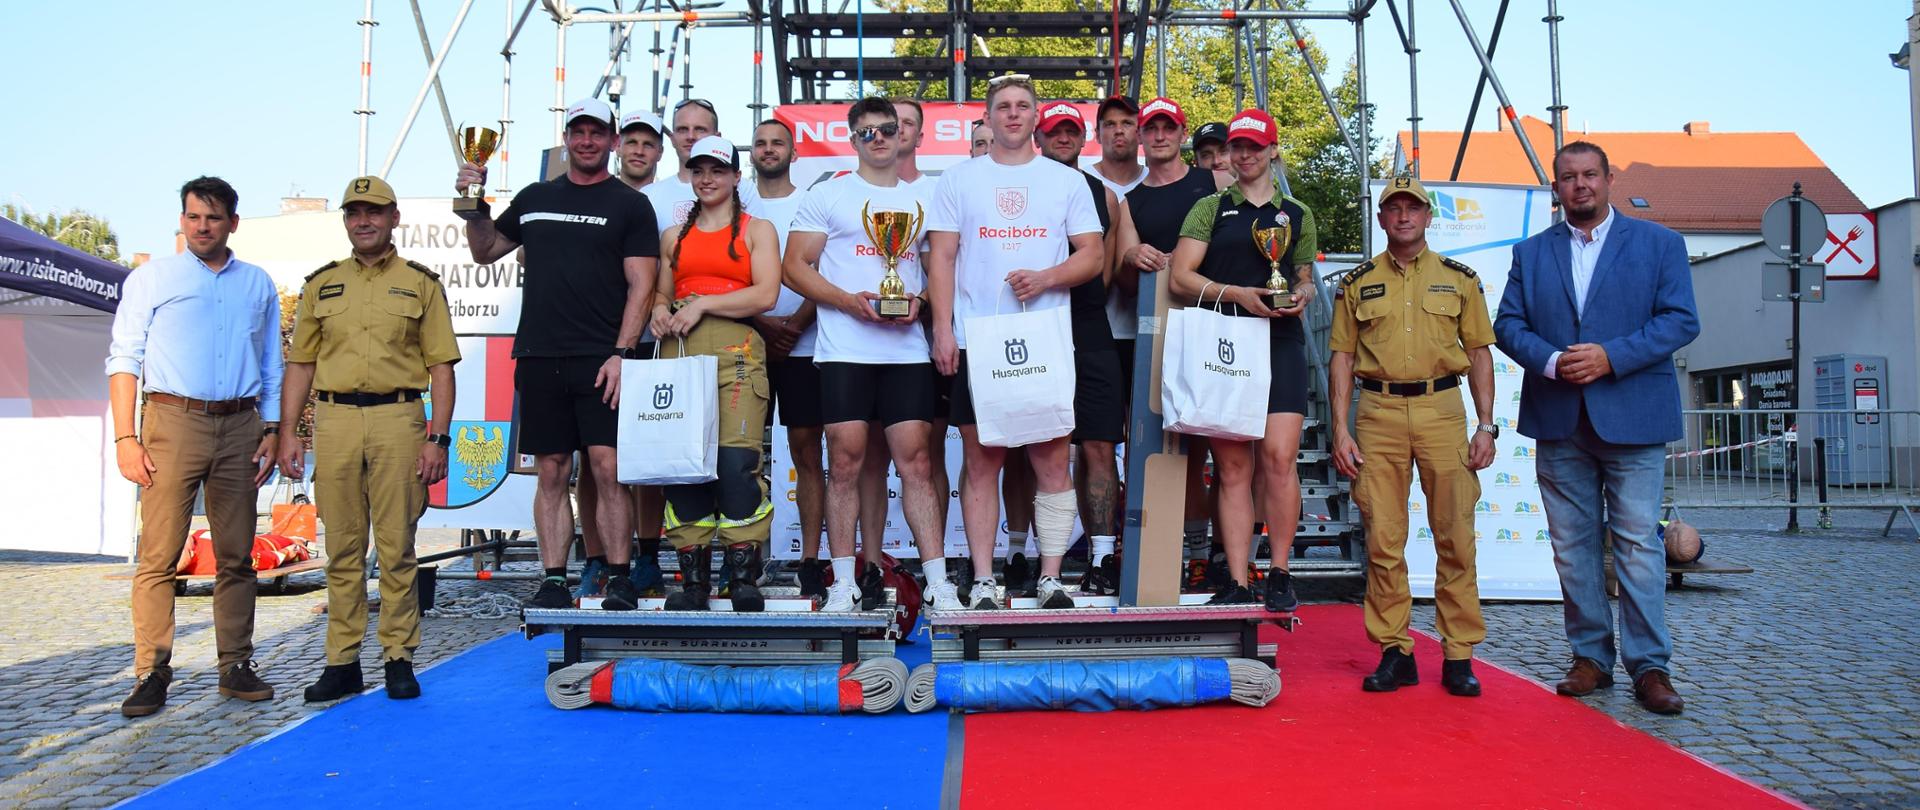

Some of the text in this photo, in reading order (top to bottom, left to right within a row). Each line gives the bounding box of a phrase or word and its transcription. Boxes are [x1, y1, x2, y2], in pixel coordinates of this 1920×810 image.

[795, 121, 851, 143] NO
[565, 214, 608, 226] ELTEN
[979, 226, 1048, 239] Racibórz
[435, 263, 525, 289] IATOWE
[992, 364, 1047, 379] Husqvarna
[1204, 361, 1251, 377] Husqvarna
[1750, 368, 1793, 387] JADŁODAJNI
[638, 411, 684, 422] Husqvarna
[622, 639, 769, 648] NEVER SURRENDER
[1056, 635, 1201, 646] NEVER SURRENDER
